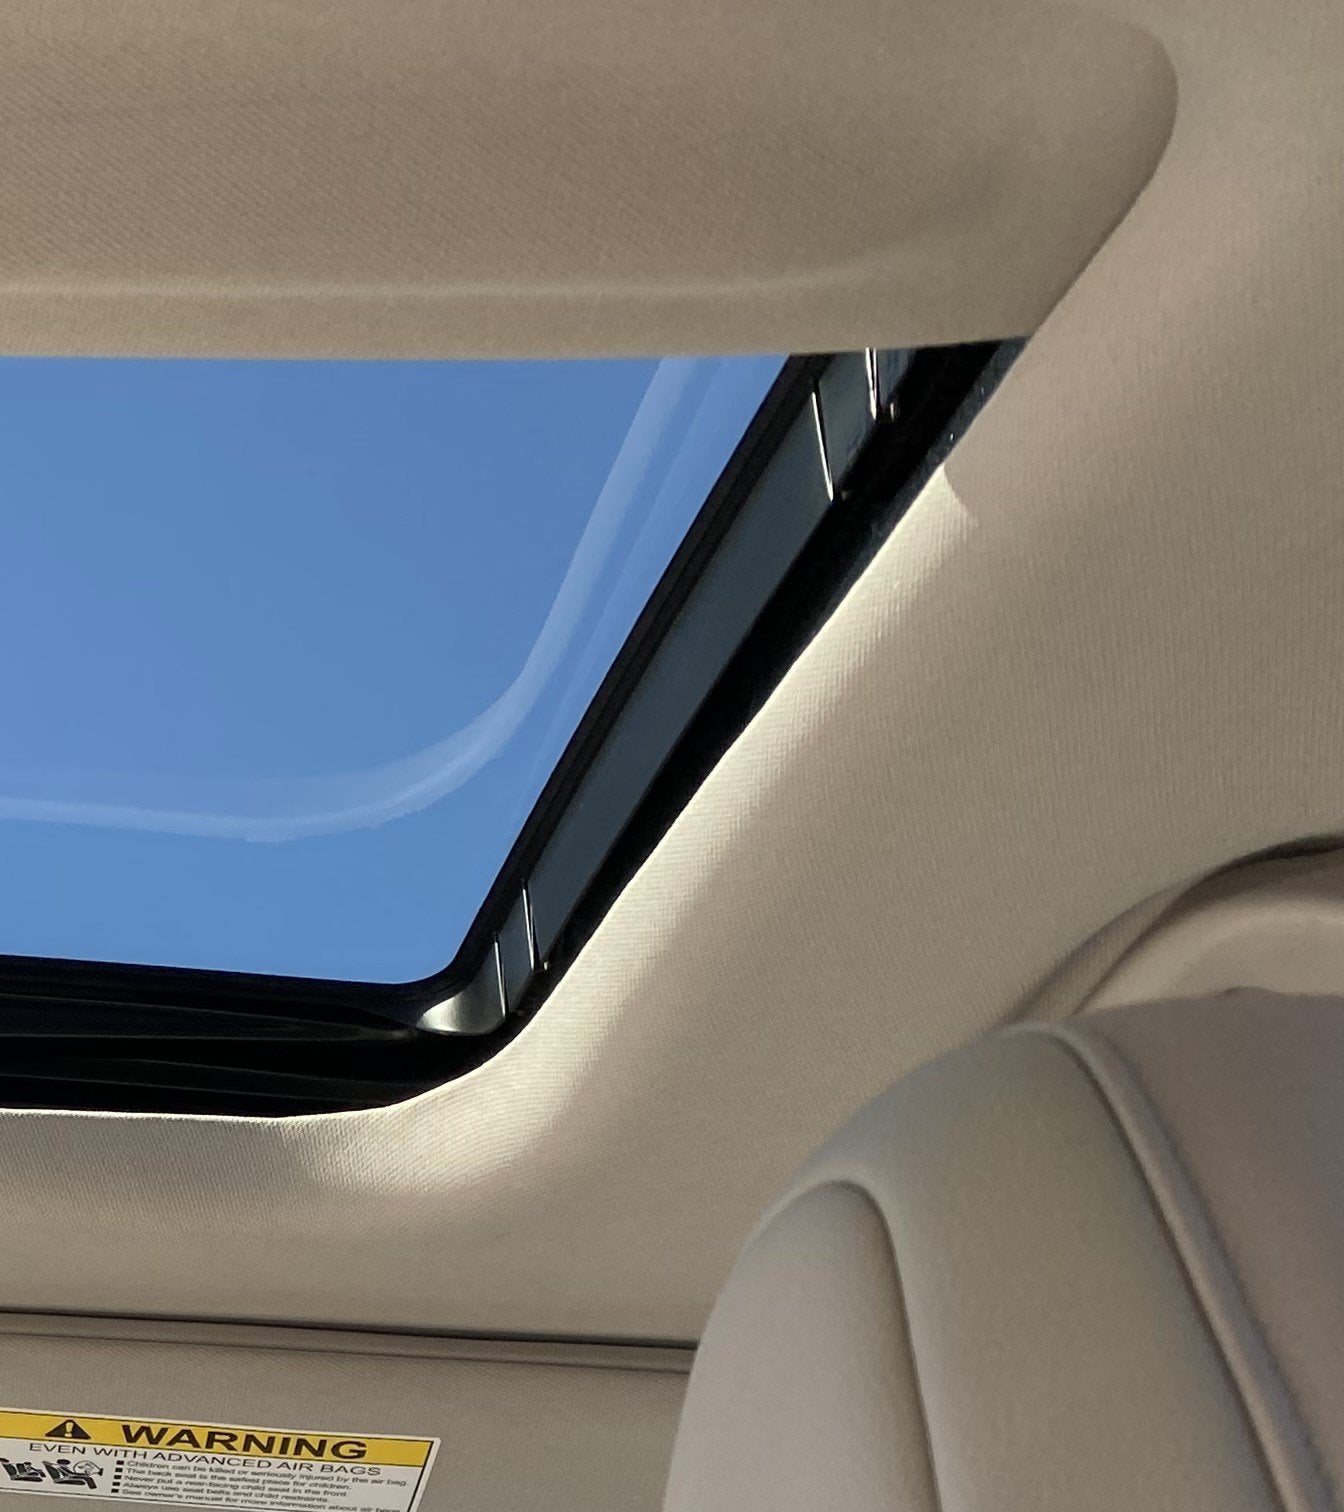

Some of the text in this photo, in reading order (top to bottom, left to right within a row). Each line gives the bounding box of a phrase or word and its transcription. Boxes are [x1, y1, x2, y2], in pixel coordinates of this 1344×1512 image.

[122, 1424, 367, 1460] WARNING
[30, 1443, 381, 1476] EVEN WITH ADVANCED AIR BAGS
